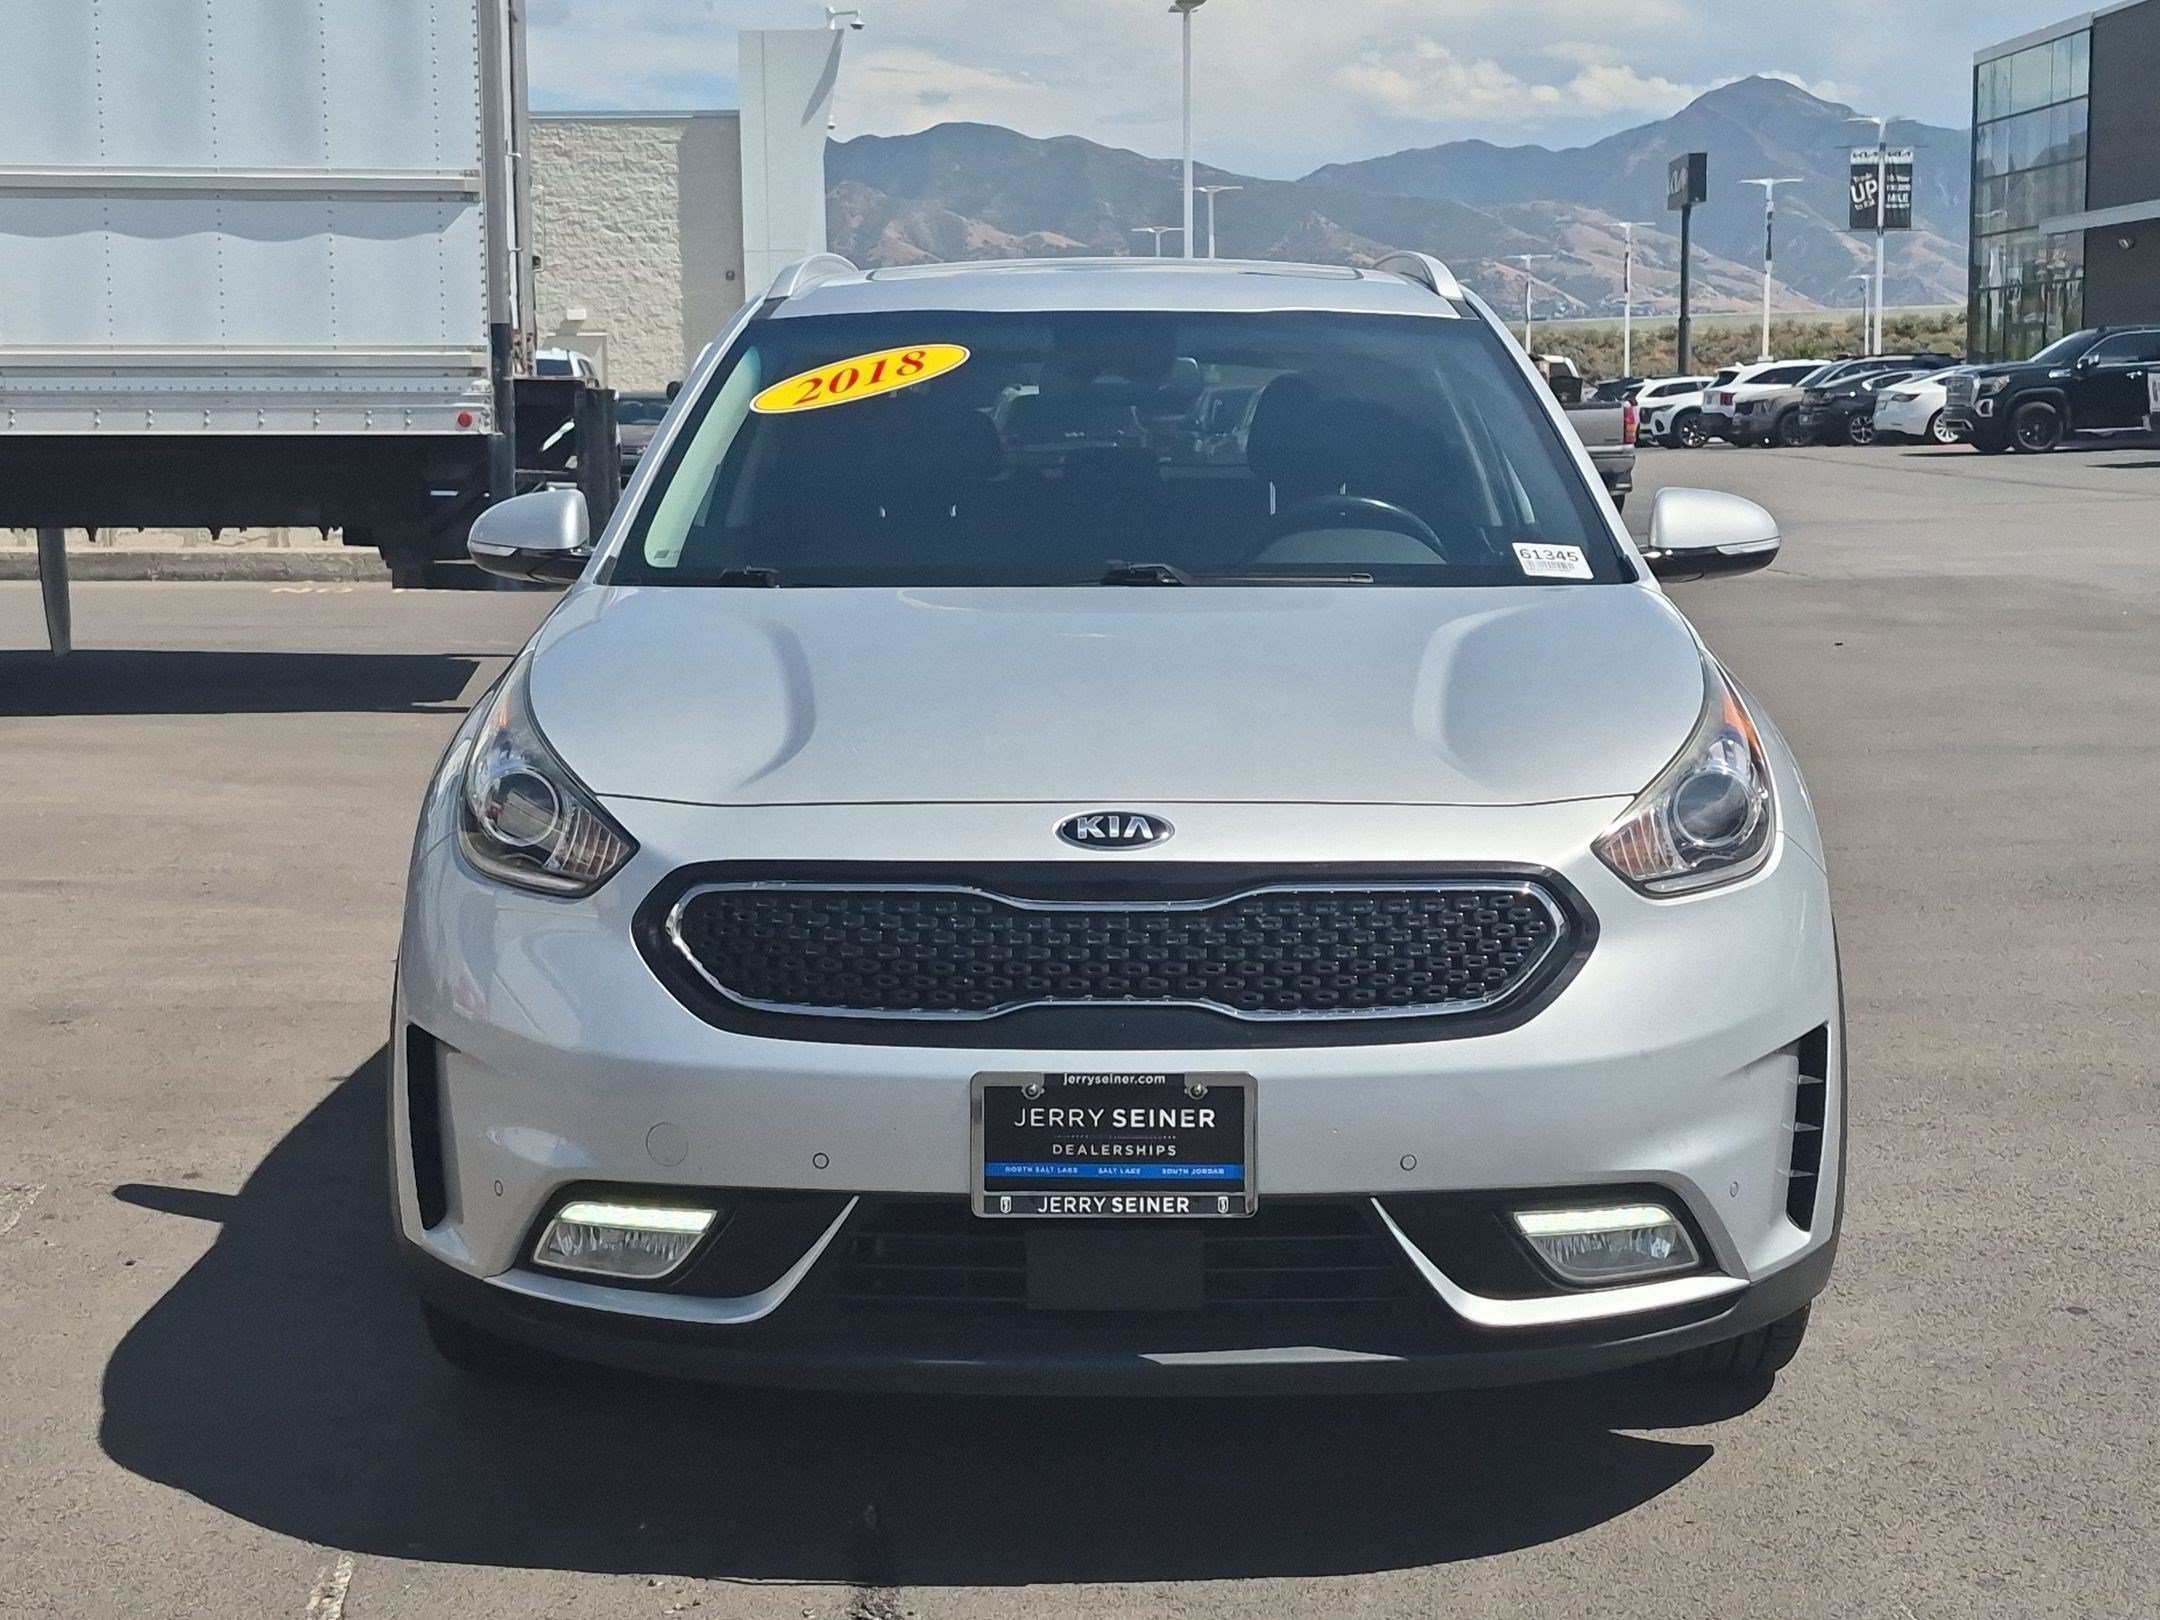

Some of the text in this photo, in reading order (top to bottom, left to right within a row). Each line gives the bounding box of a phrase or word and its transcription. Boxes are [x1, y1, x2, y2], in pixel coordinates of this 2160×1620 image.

[1850, 179, 1878, 204] UP
[793, 350, 927, 406] 2018
[1519, 548, 1579, 562] 61345
[1077, 815, 1154, 839] KIA
[1063, 1073, 1166, 1086] jerryseiner.com
[1014, 1108, 1216, 1129] JERRY SEINER
[1052, 1143, 1177, 1157] DEALERSHIPS
[1035, 1165, 1054, 1174] SALT
[1057, 1166, 1078, 1175] LAKE
[1098, 1167, 1141, 1175] SALT LAKE
[1161, 1167, 1225, 1176] SOUTH JORDAN
[1037, 1196, 1190, 1213] JERRY SEINER
